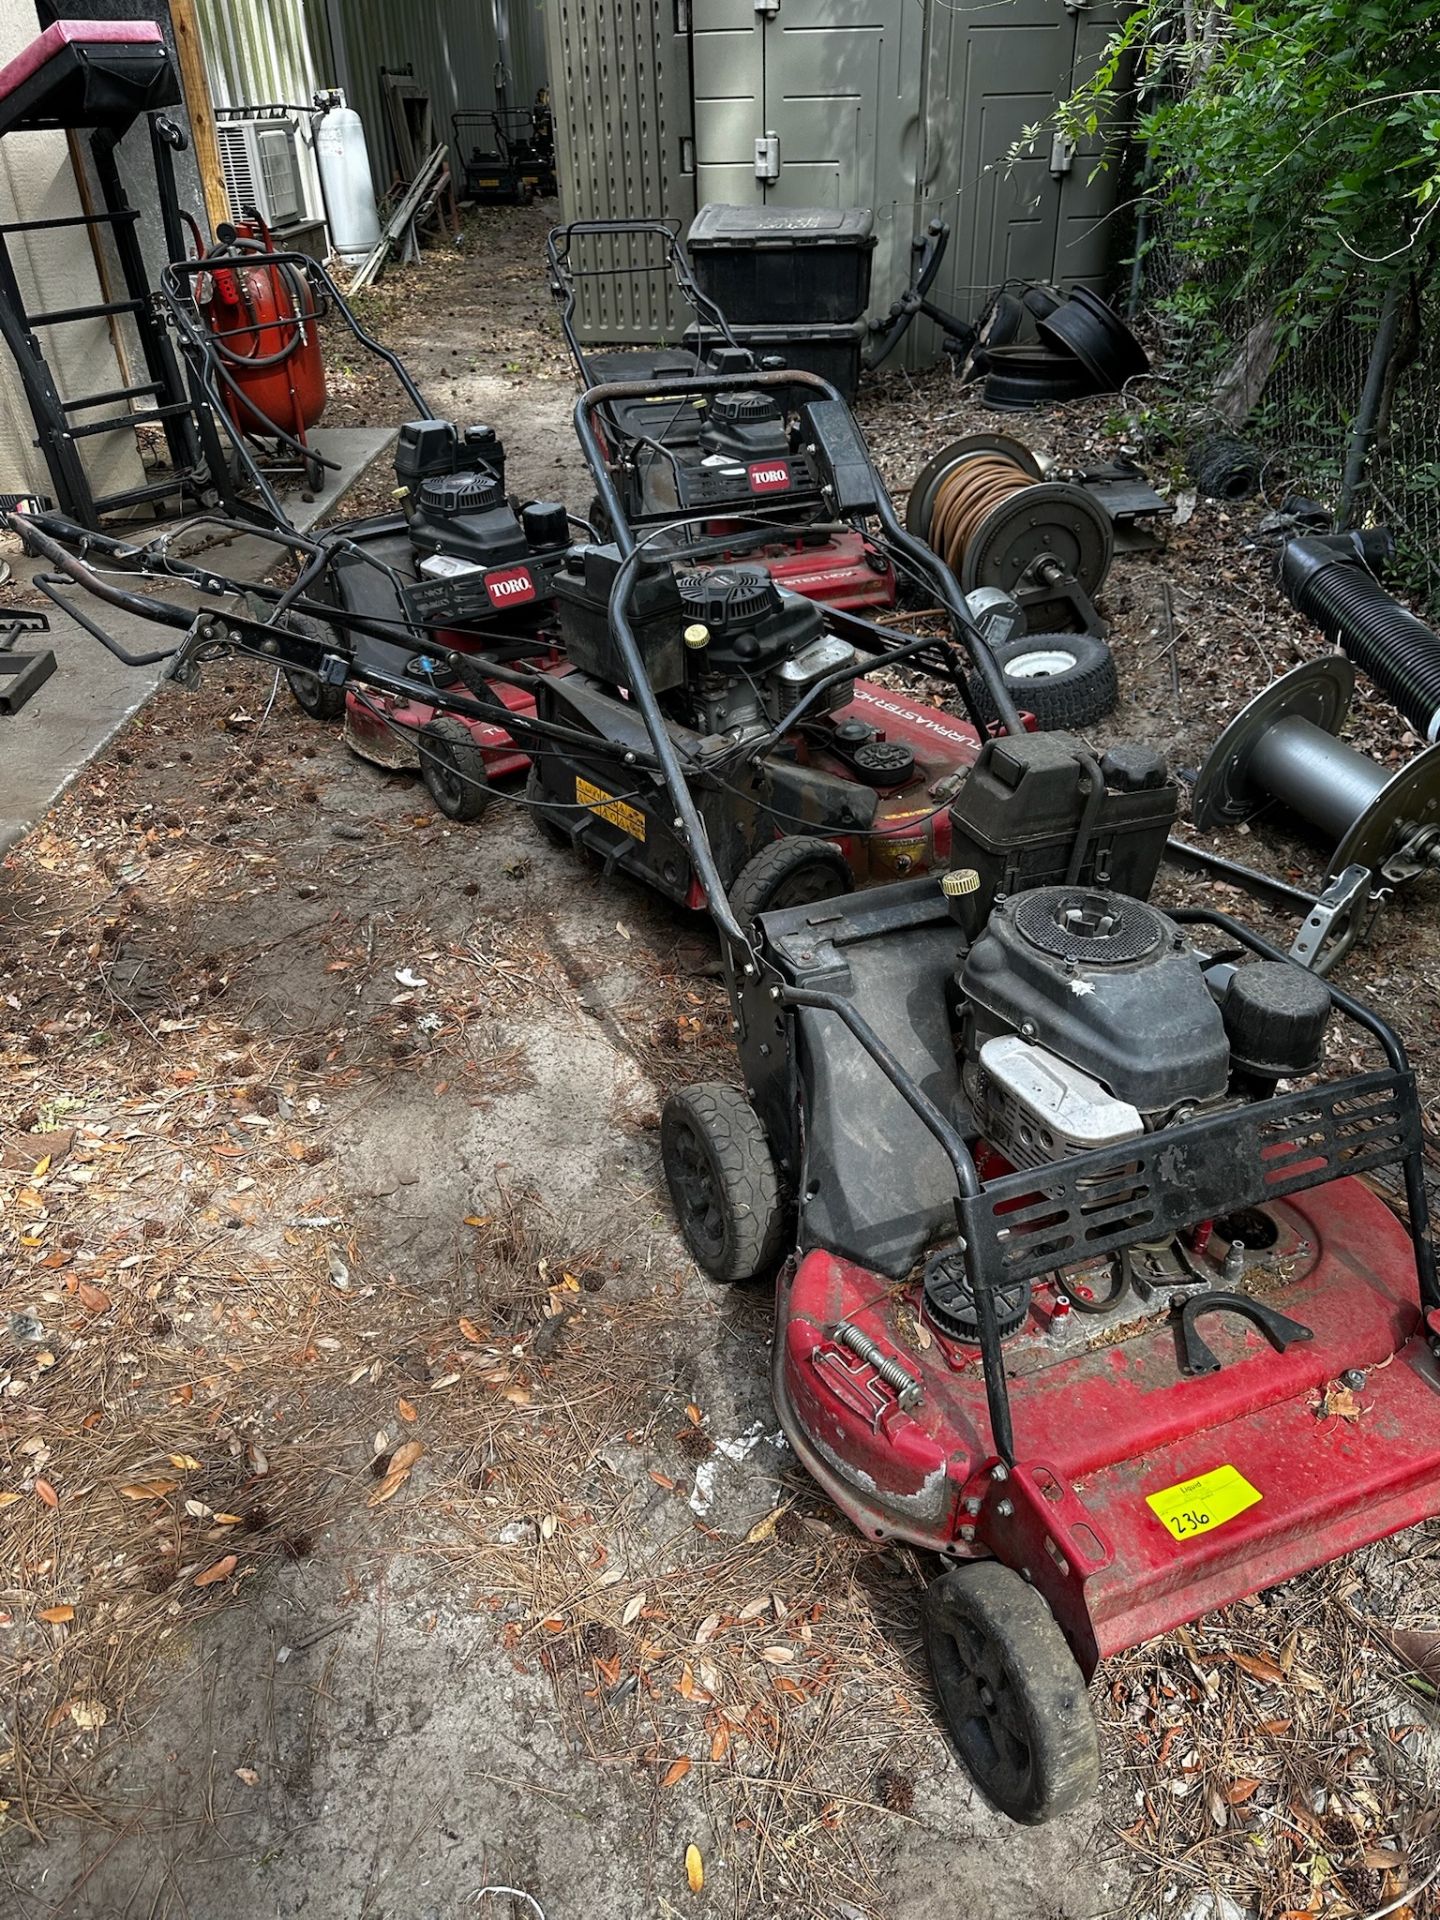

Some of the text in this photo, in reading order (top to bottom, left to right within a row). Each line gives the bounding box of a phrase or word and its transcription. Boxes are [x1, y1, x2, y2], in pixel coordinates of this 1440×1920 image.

[752, 470, 787, 484] TORO
[490, 577, 531, 597] TORO
[853, 688, 983, 751] TURFMASTER HD
[1171, 1510, 1209, 1533] 236
